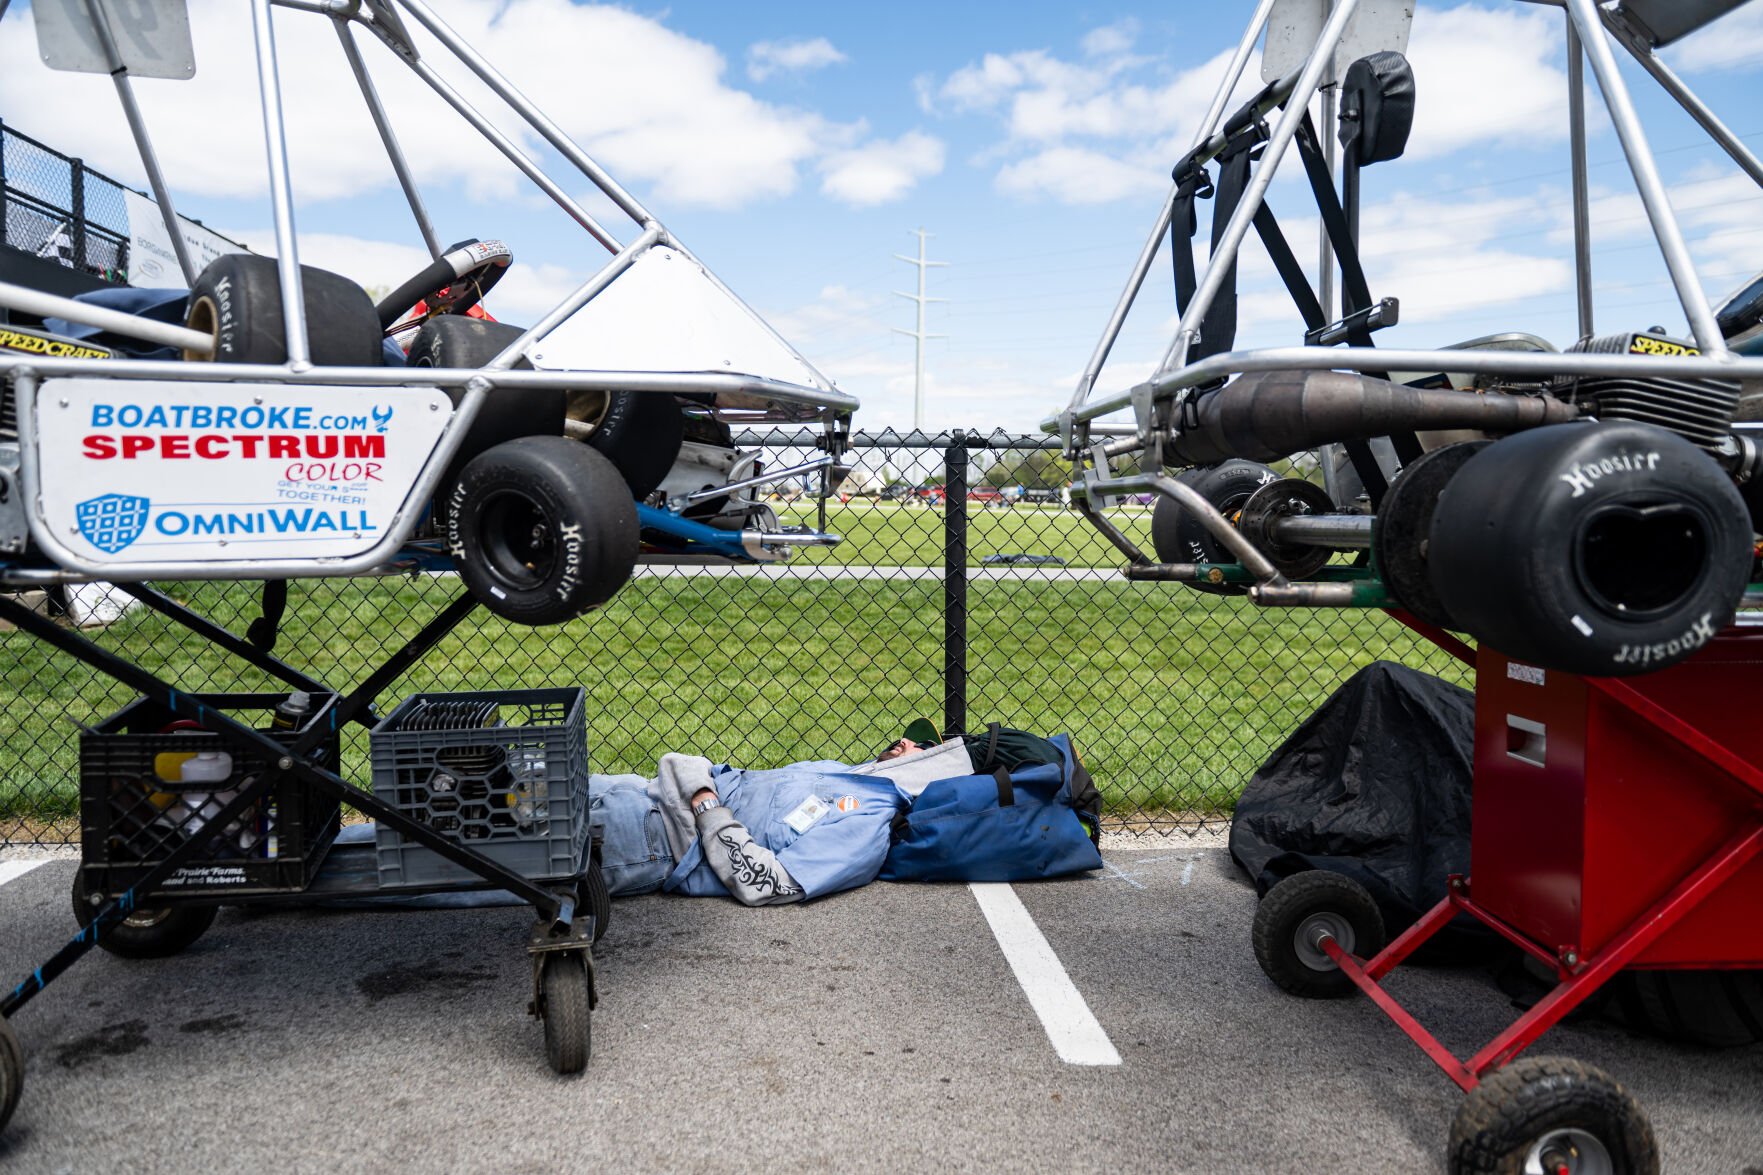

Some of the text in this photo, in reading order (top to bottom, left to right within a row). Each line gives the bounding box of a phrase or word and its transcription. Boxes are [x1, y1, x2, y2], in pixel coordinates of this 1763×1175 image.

[0, 329, 110, 359] PEEDCRAFT
[82, 435, 386, 459] SPECTRUM
[285, 462, 384, 482] COLOR
[1559, 448, 1661, 498] Hoosier
[276, 488, 367, 506] TOGETHER!
[277, 480, 301, 488] GET
[305, 482, 339, 492] YOUR
[155, 507, 378, 536] OMNIWALL
[448, 483, 467, 560] Hoosier
[556, 520, 586, 602] Hoosier
[205, 875, 247, 884] Roberts
